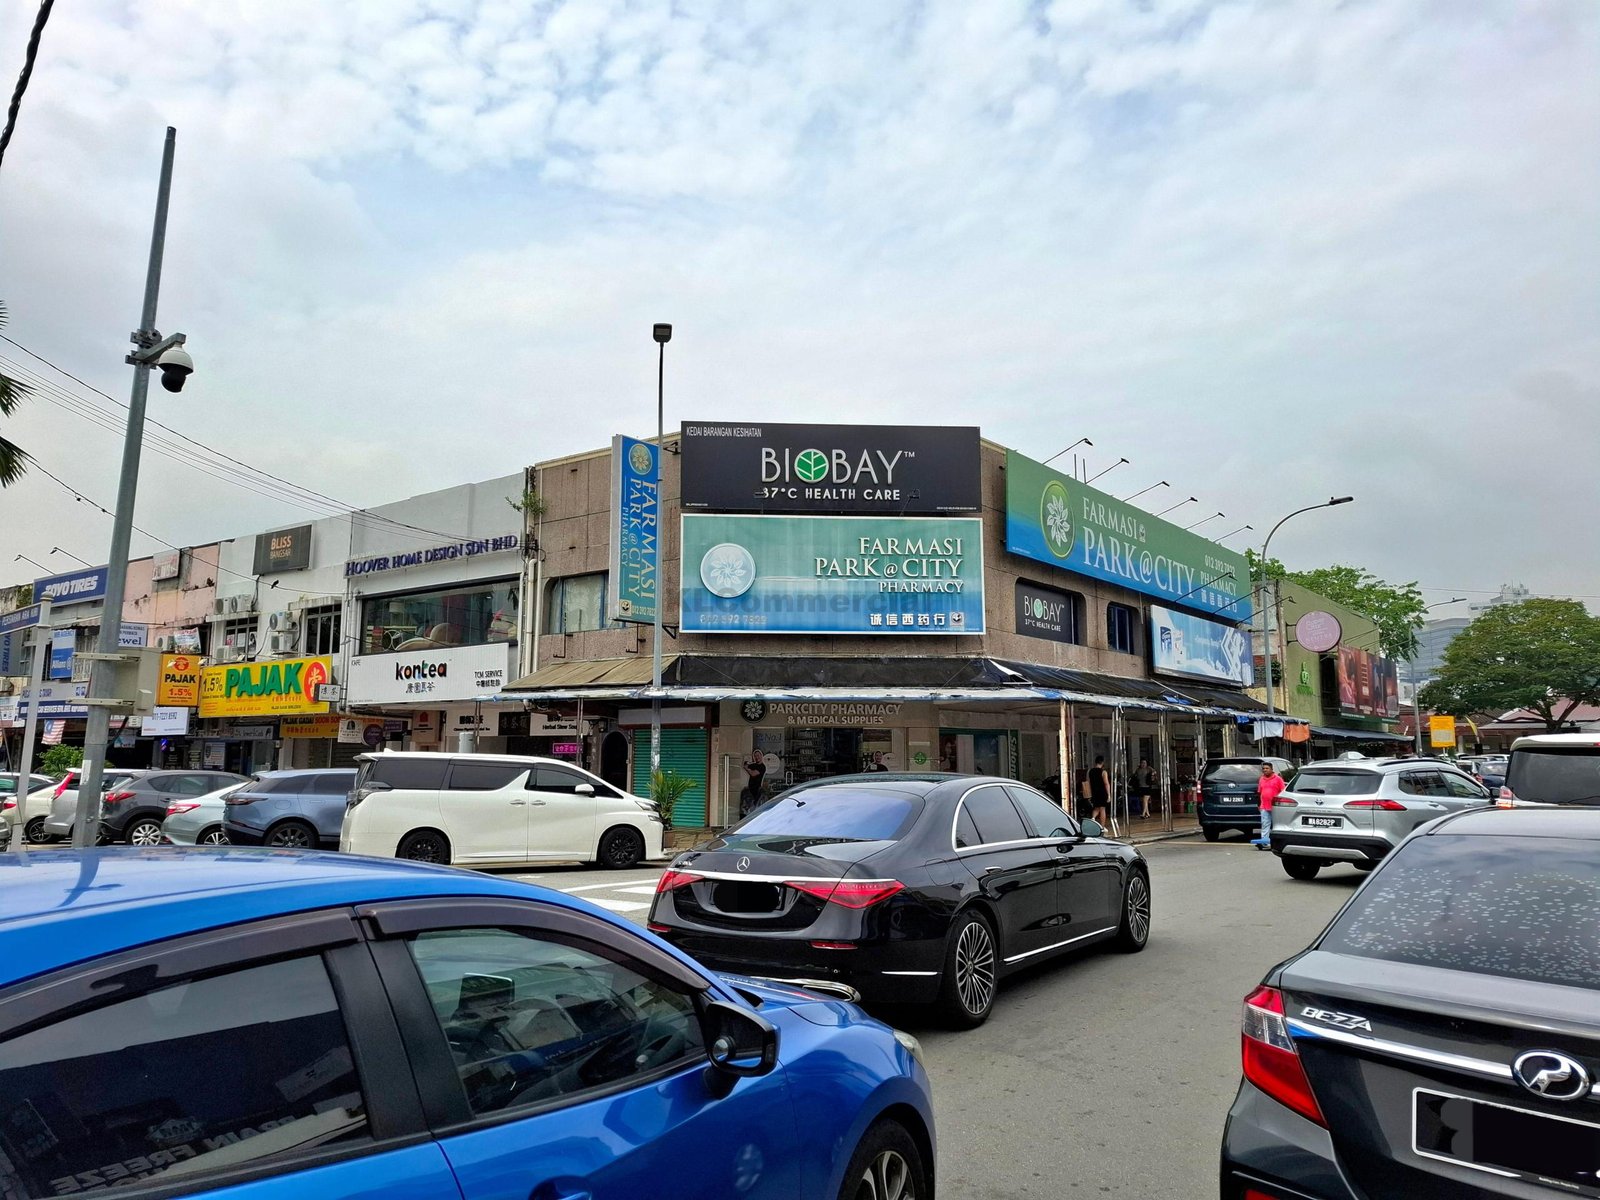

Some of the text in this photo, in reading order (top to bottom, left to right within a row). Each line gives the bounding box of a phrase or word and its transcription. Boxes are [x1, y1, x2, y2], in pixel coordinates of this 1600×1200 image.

[686, 426, 762, 438] KEDAI BARANGAN KESIHATAN
[805, 488, 856, 500] HEALTH
[863, 488, 901, 501] CARE
[1082, 496, 1138, 540] FARMASI
[270, 535, 292, 550] BLISS
[620, 506, 630, 568] PHARMACY
[640, 479, 657, 599] FARMASI
[270, 548, 292, 560] BANGSAR
[858, 537, 964, 557] FARMASI
[344, 556, 390, 576] HOOVER
[392, 551, 422, 568] HOME
[424, 543, 463, 564] DESIGN
[465, 538, 489, 556] SDN
[492, 534, 518, 552] BHD
[70, 575, 98, 593] TIRES
[878, 580, 964, 594] PHARMACY
[1200, 571, 1238, 596] PHARMACY
[870, 613, 946, 626] 诚信西药行
[1036, 621, 1050, 630] HEALTH
[118, 637, 142, 646] ewel
[395, 660, 448, 681] kontea
[164, 674, 196, 684] PAJAK
[203, 677, 223, 692] 1.5%
[224, 662, 304, 698] PAJAK
[169, 688, 192, 696] 1.5%
[769, 703, 902, 716] PARKCITY PHARMACY
[282, 716, 298, 725] PAJAK
[787, 716, 884, 725] & MEDICAL SUPPLIES
[1300, 1006, 1373, 1032] BEZZA
